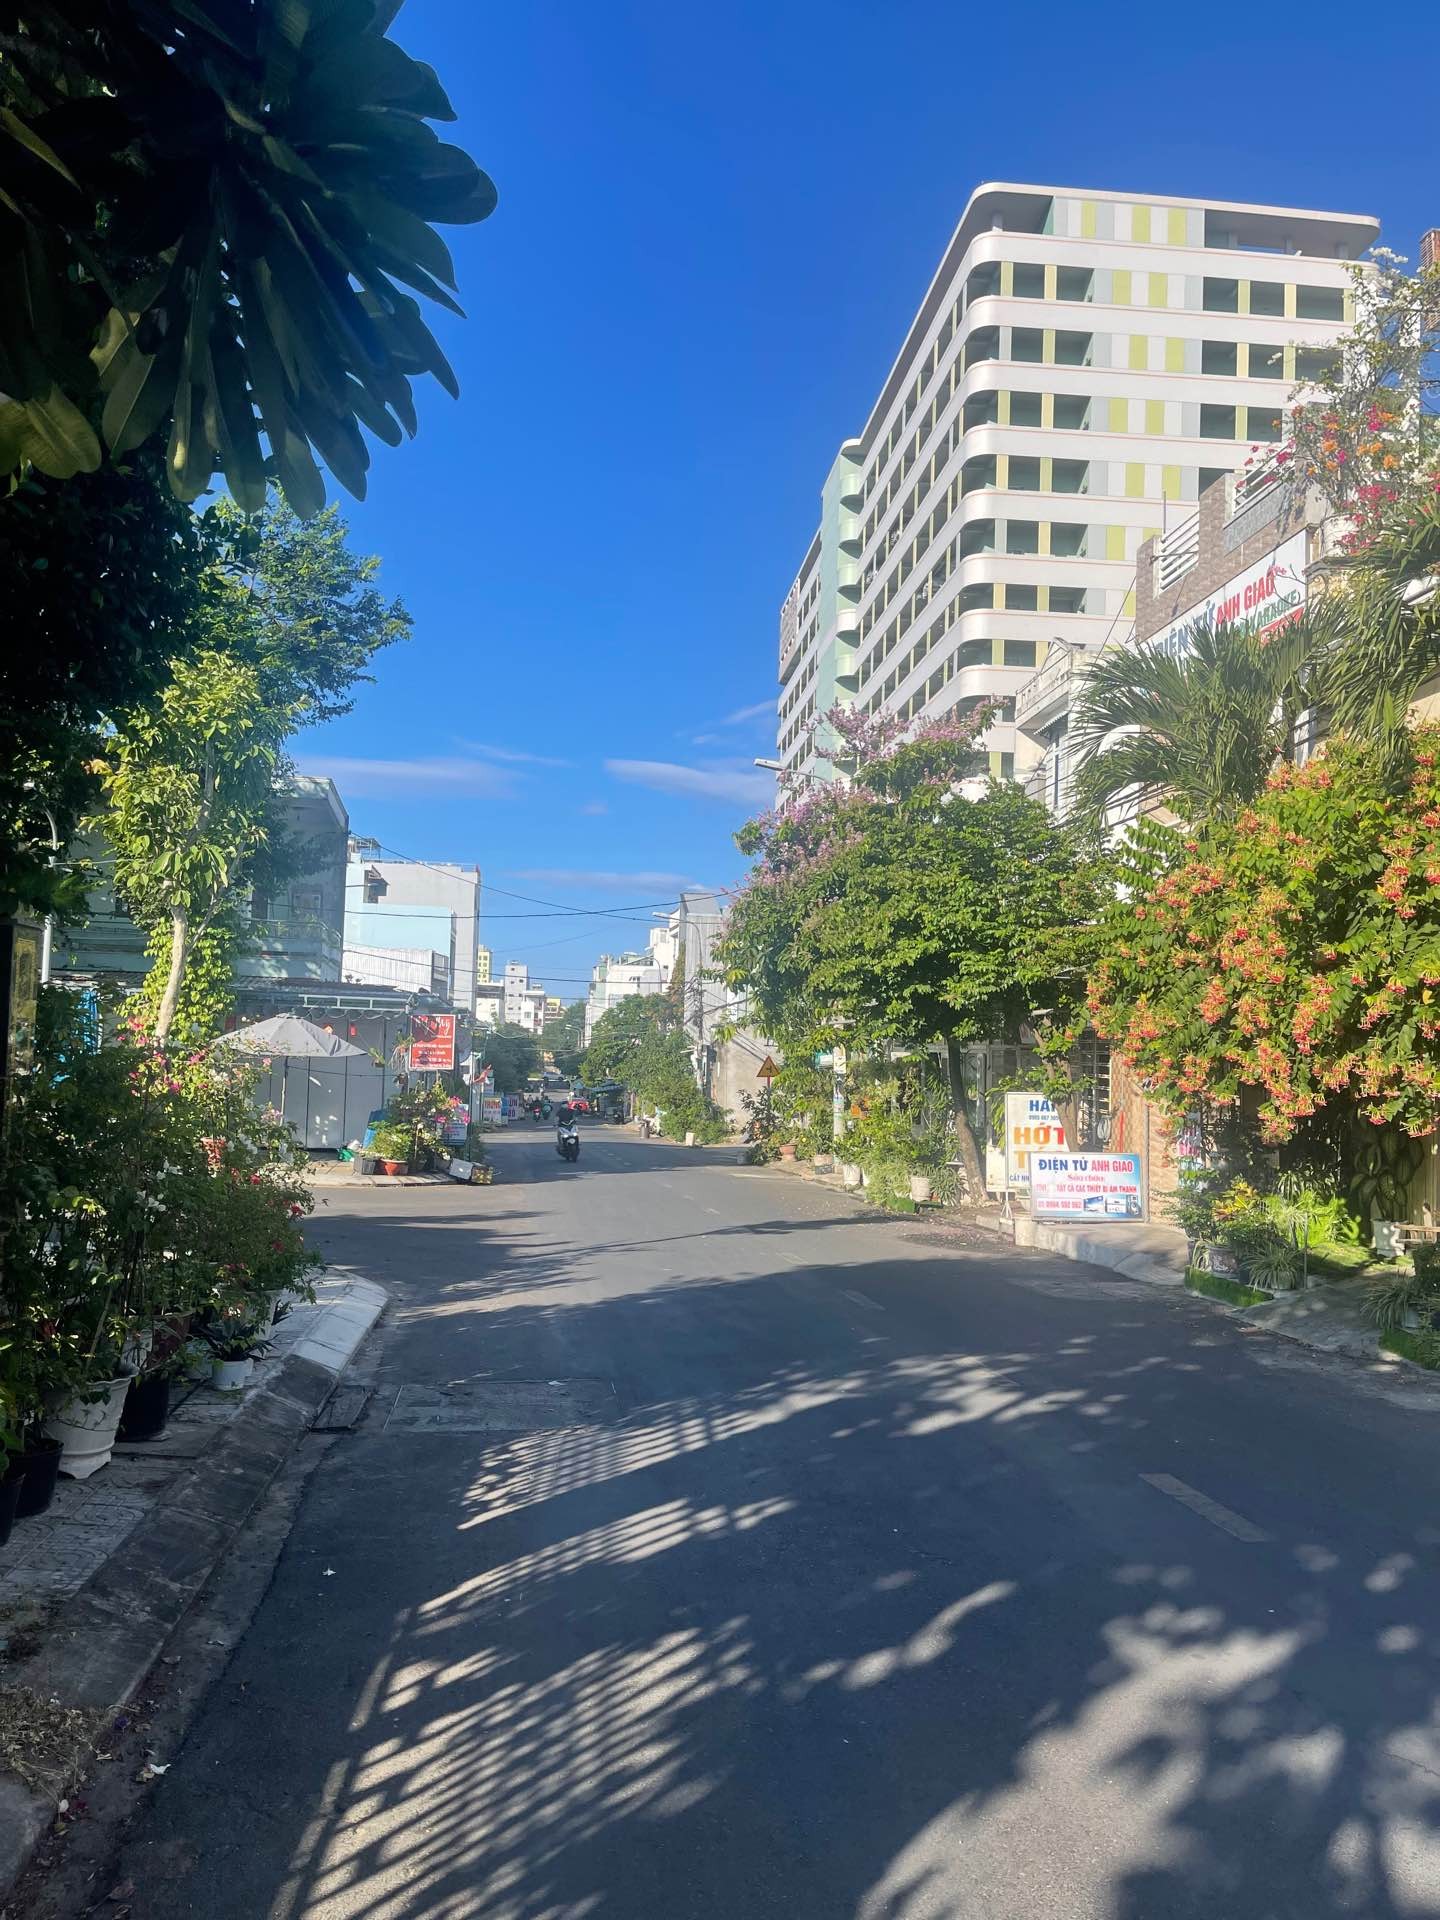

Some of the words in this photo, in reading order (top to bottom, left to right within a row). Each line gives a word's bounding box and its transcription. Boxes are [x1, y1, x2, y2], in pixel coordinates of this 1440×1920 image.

[1216, 592, 1240, 625] ANH
[1244, 569, 1275, 611] GIAO
[1013, 1122, 1065, 1145] HỚT
[1038, 1157, 1068, 1174] ĐIỆN
[1072, 1156, 1088, 1171] TỬ
[1091, 1159, 1110, 1172] ANH
[1112, 1160, 1133, 1173] GIAO
